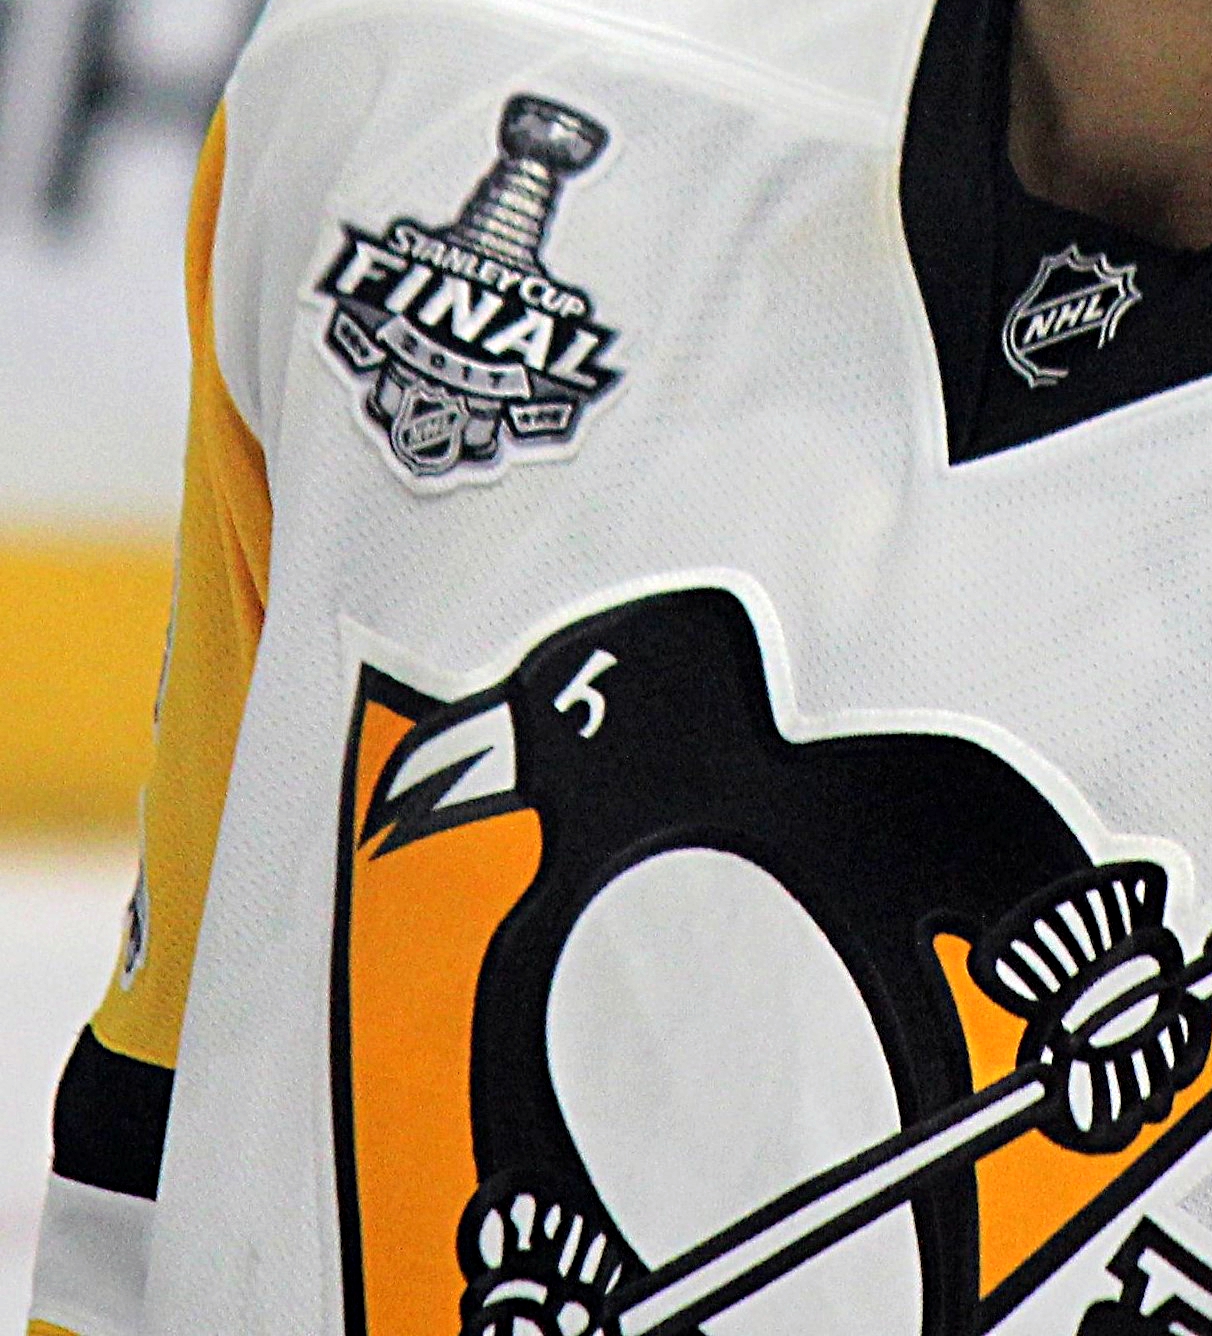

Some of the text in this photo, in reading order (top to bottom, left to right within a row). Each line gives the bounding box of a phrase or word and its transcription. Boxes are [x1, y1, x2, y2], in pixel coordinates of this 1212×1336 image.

[334, 237, 600, 389] FINAL
[387, 225, 587, 318] STANLEY CUP
[1022, 292, 1105, 345] NHL
